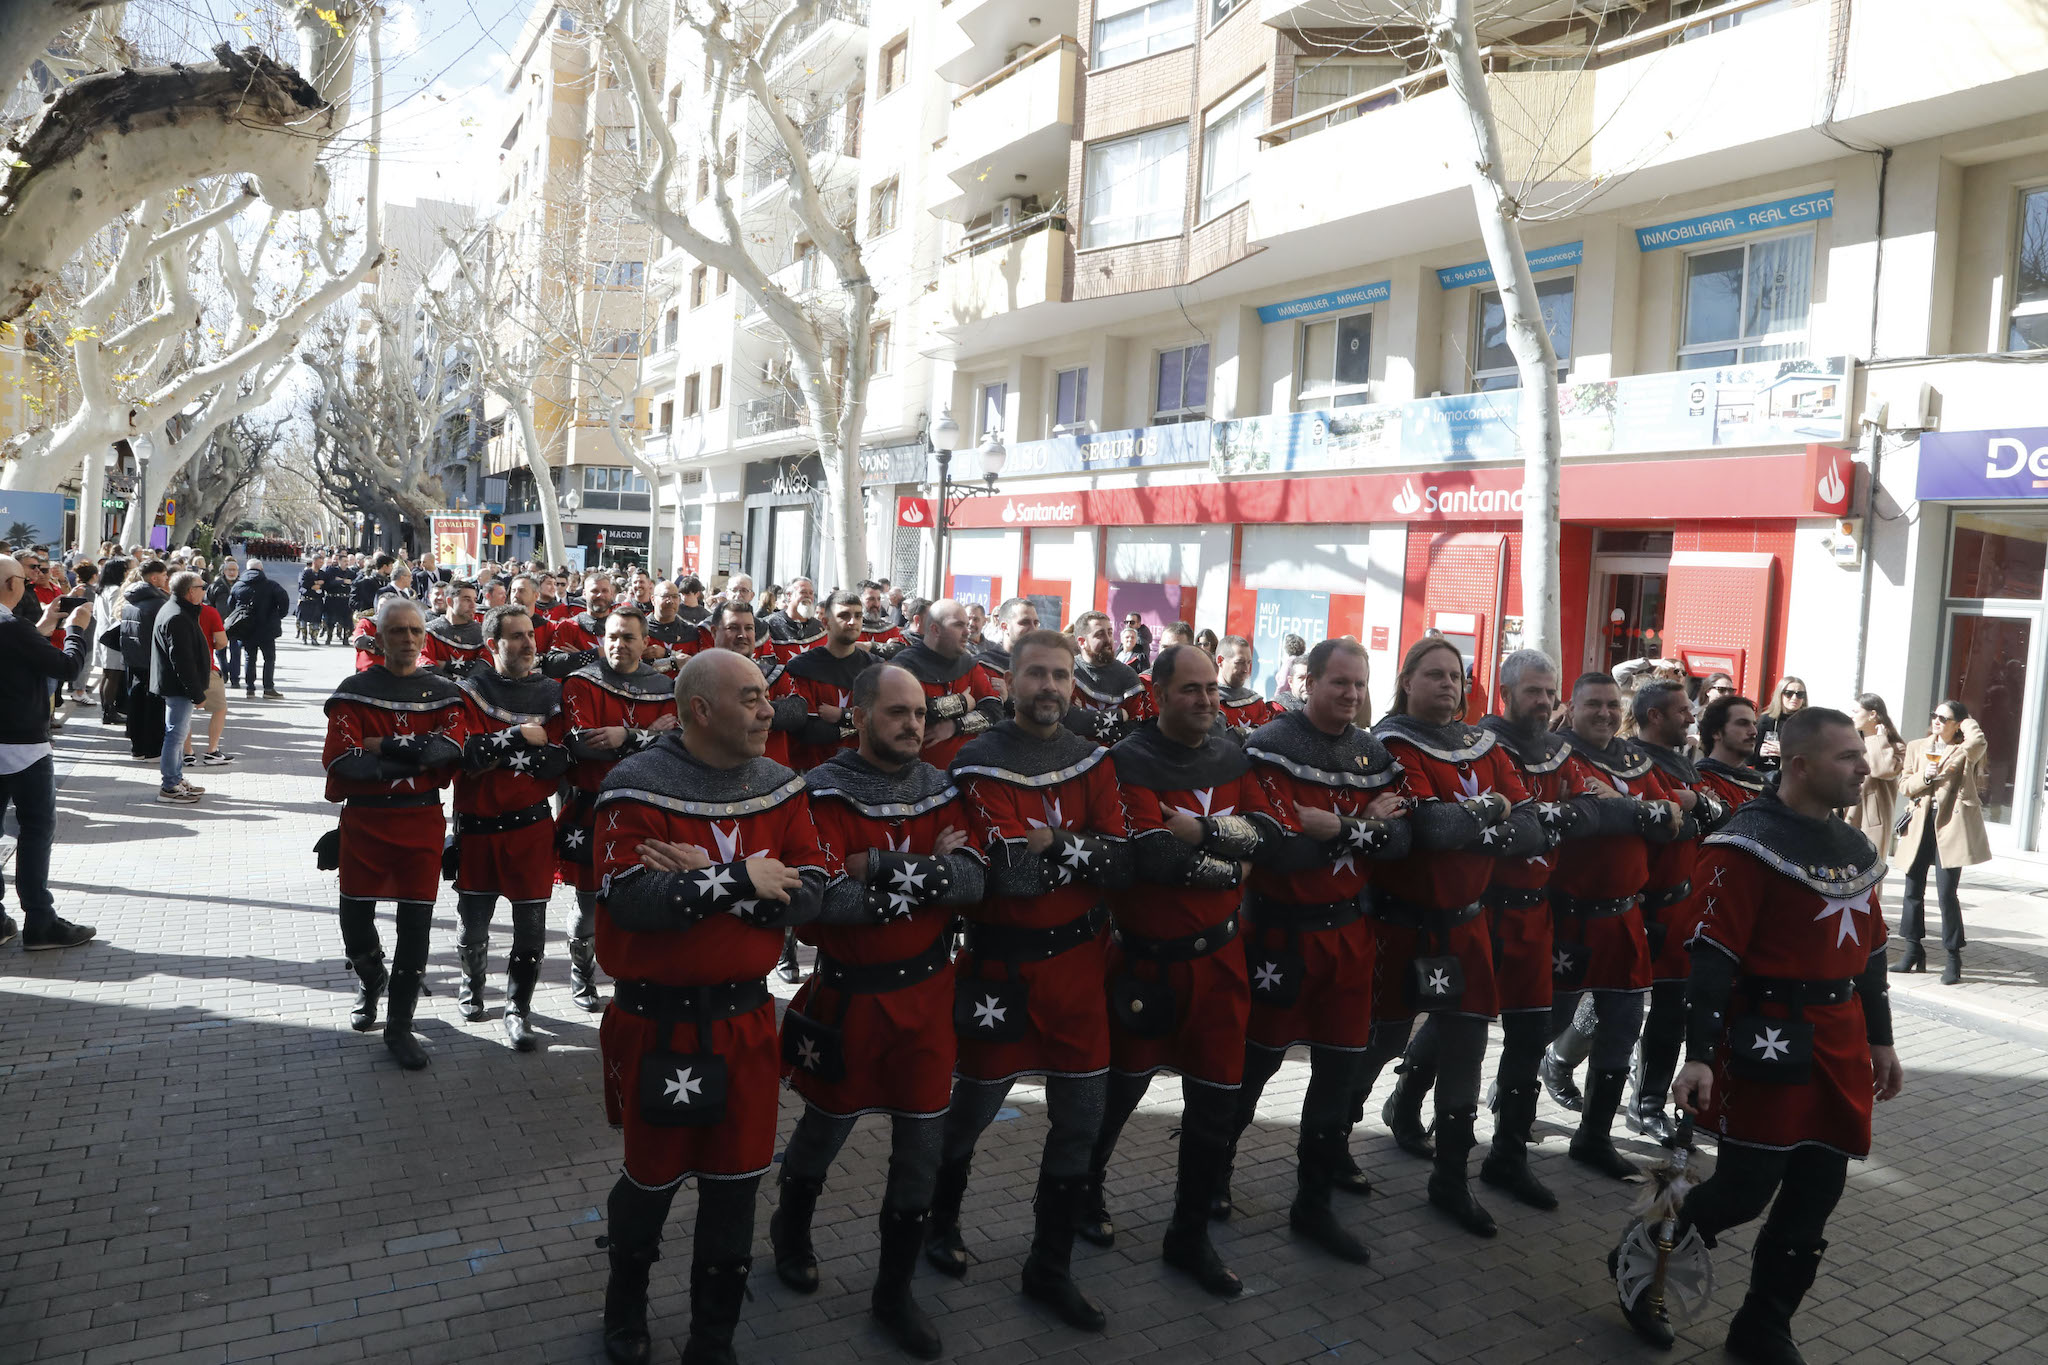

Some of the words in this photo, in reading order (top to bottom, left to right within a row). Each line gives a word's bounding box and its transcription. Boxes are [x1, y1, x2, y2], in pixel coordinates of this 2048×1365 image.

[1642, 217, 1735, 246] INMOBILIARIA
[1749, 207, 1786, 225] REAL
[1278, 298, 1329, 316] IMMOBILIER
[1337, 286, 1388, 305] MAKELAAR
[1080, 436, 1158, 462] SEGUROS
[865, 453, 890, 471] PONS
[772, 474, 809, 495] MANGO
[1016, 502, 1076, 522] Santander
[609, 531, 642, 539] MACSON
[1260, 602, 1280, 615] MUY
[1258, 615, 1324, 641] FUERTE
